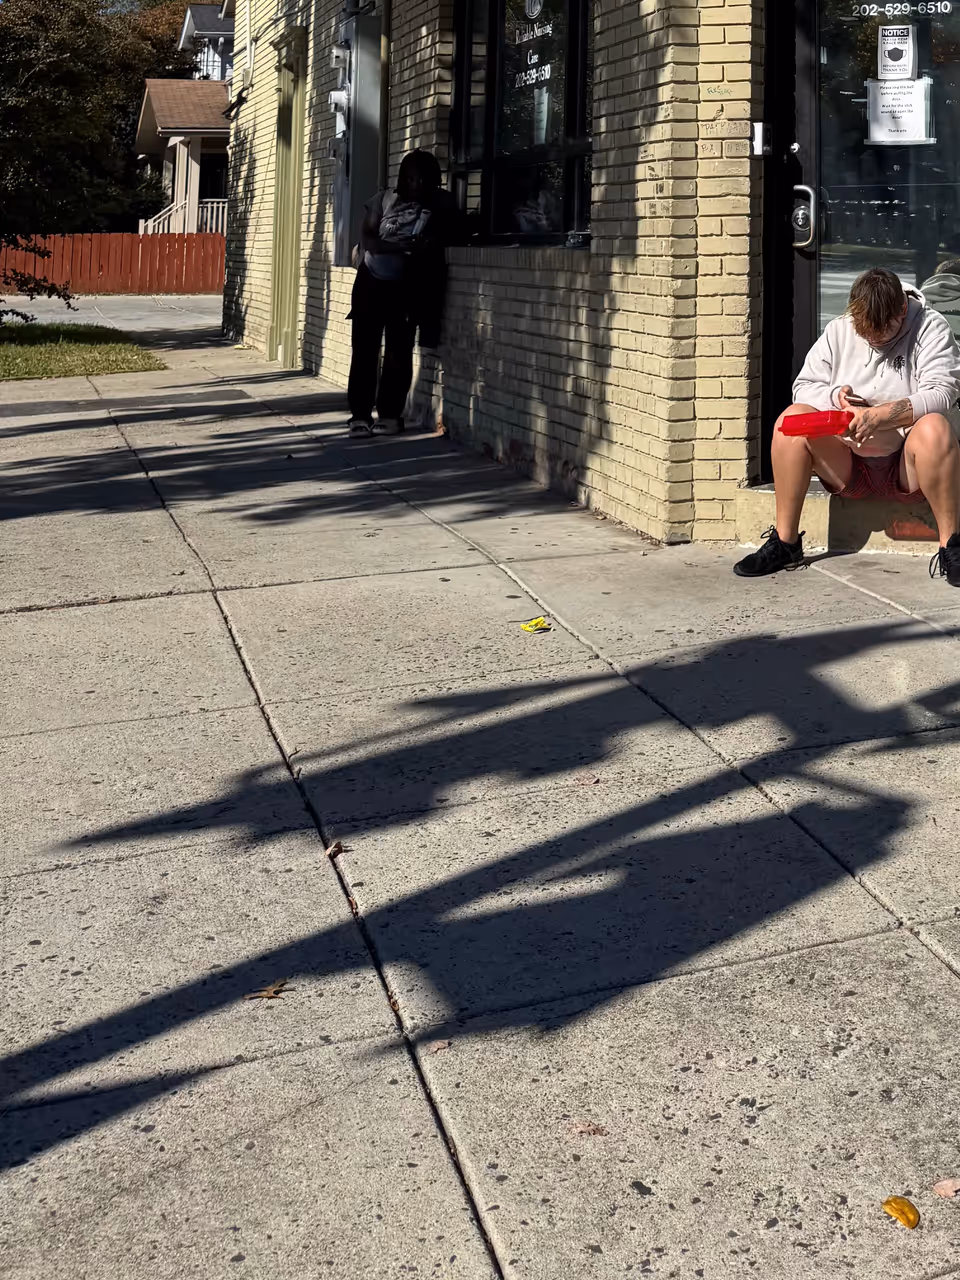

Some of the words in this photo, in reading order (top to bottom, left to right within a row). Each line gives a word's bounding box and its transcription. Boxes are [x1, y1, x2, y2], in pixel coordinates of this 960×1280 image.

[852, 1, 952, 17] 202-529-6510
[527, 49, 539, 65] Care
[515, 64, 551, 88] 202-529-6510
